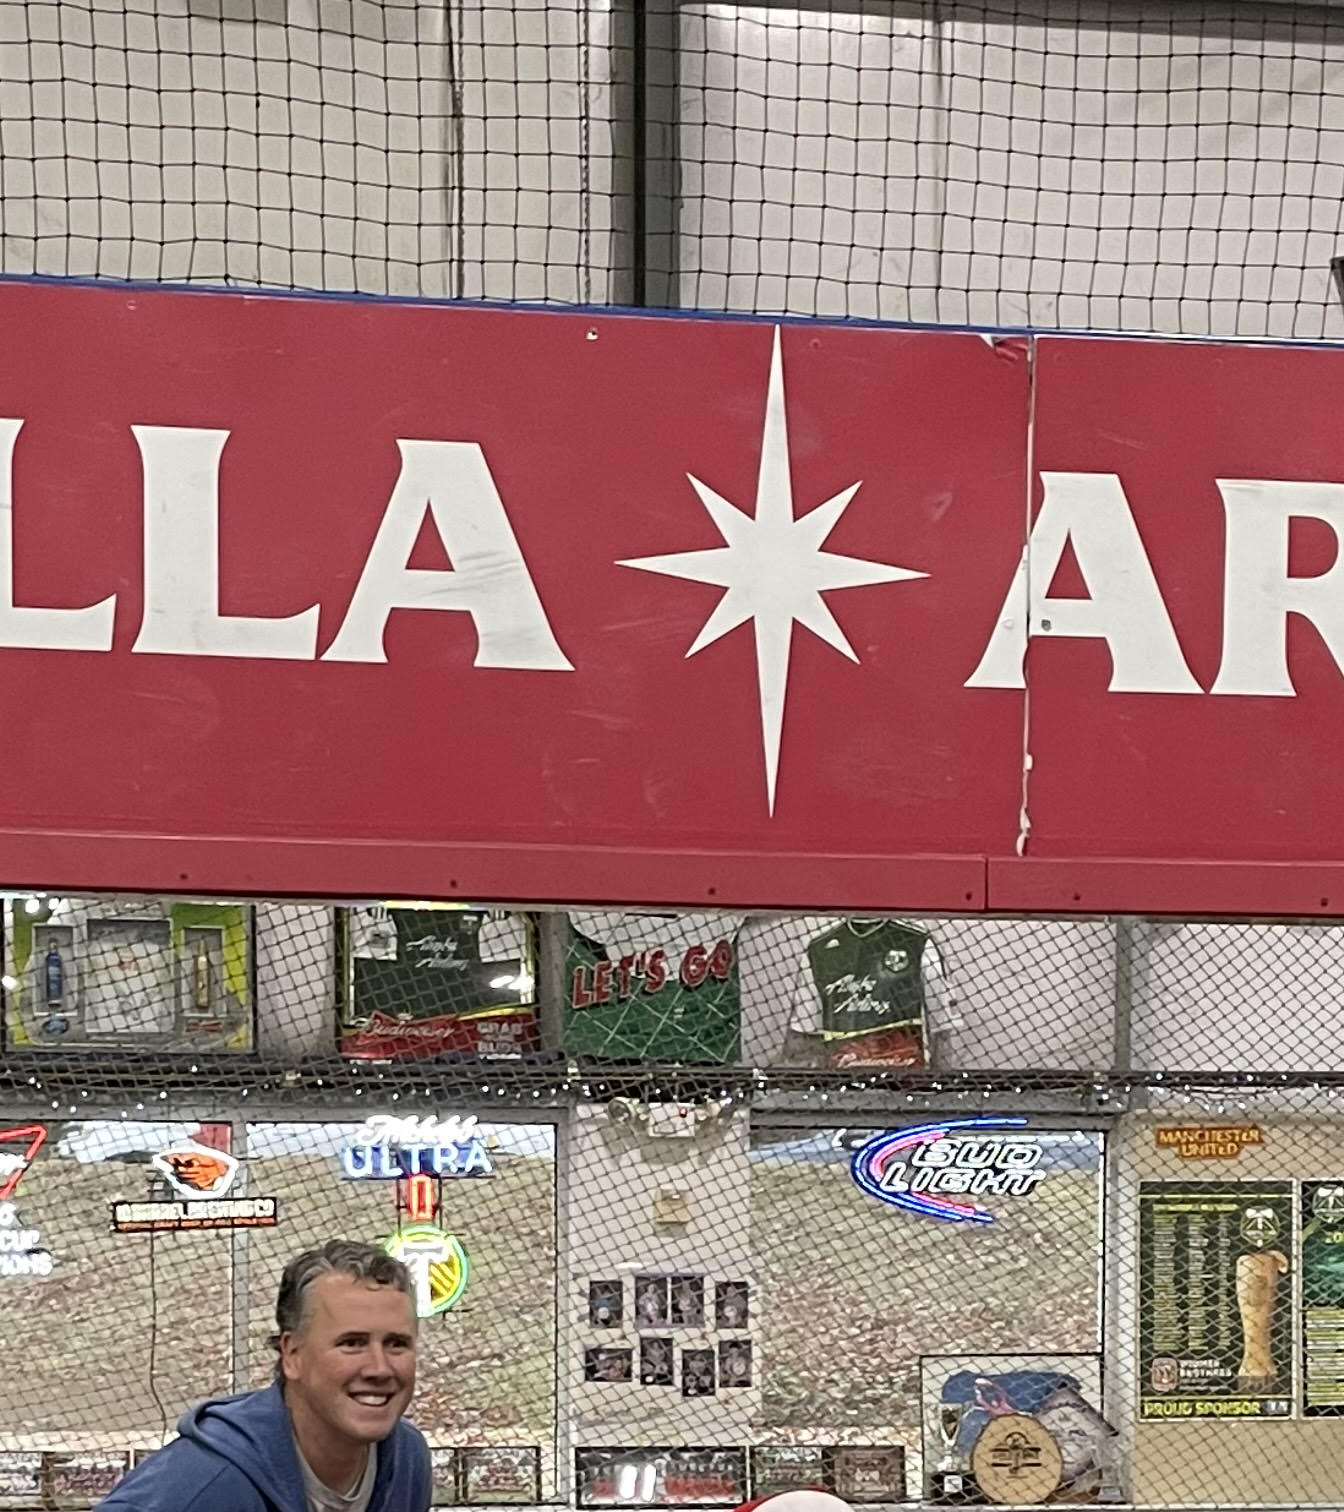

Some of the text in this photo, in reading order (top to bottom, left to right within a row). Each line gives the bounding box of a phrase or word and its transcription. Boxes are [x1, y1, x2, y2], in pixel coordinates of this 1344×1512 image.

[572, 938, 734, 1009] LET'S GO
[1158, 1129, 1260, 1143] MANCHESTER
[1181, 1142, 1238, 1156] UNITED
[343, 1140, 493, 1178] ULTRA
[911, 1138, 1043, 1169] BUD
[879, 1161, 1047, 1195] LIGHT
[1144, 1402, 1192, 1416] PROUD
[1195, 1401, 1261, 1415] SPONSOR
